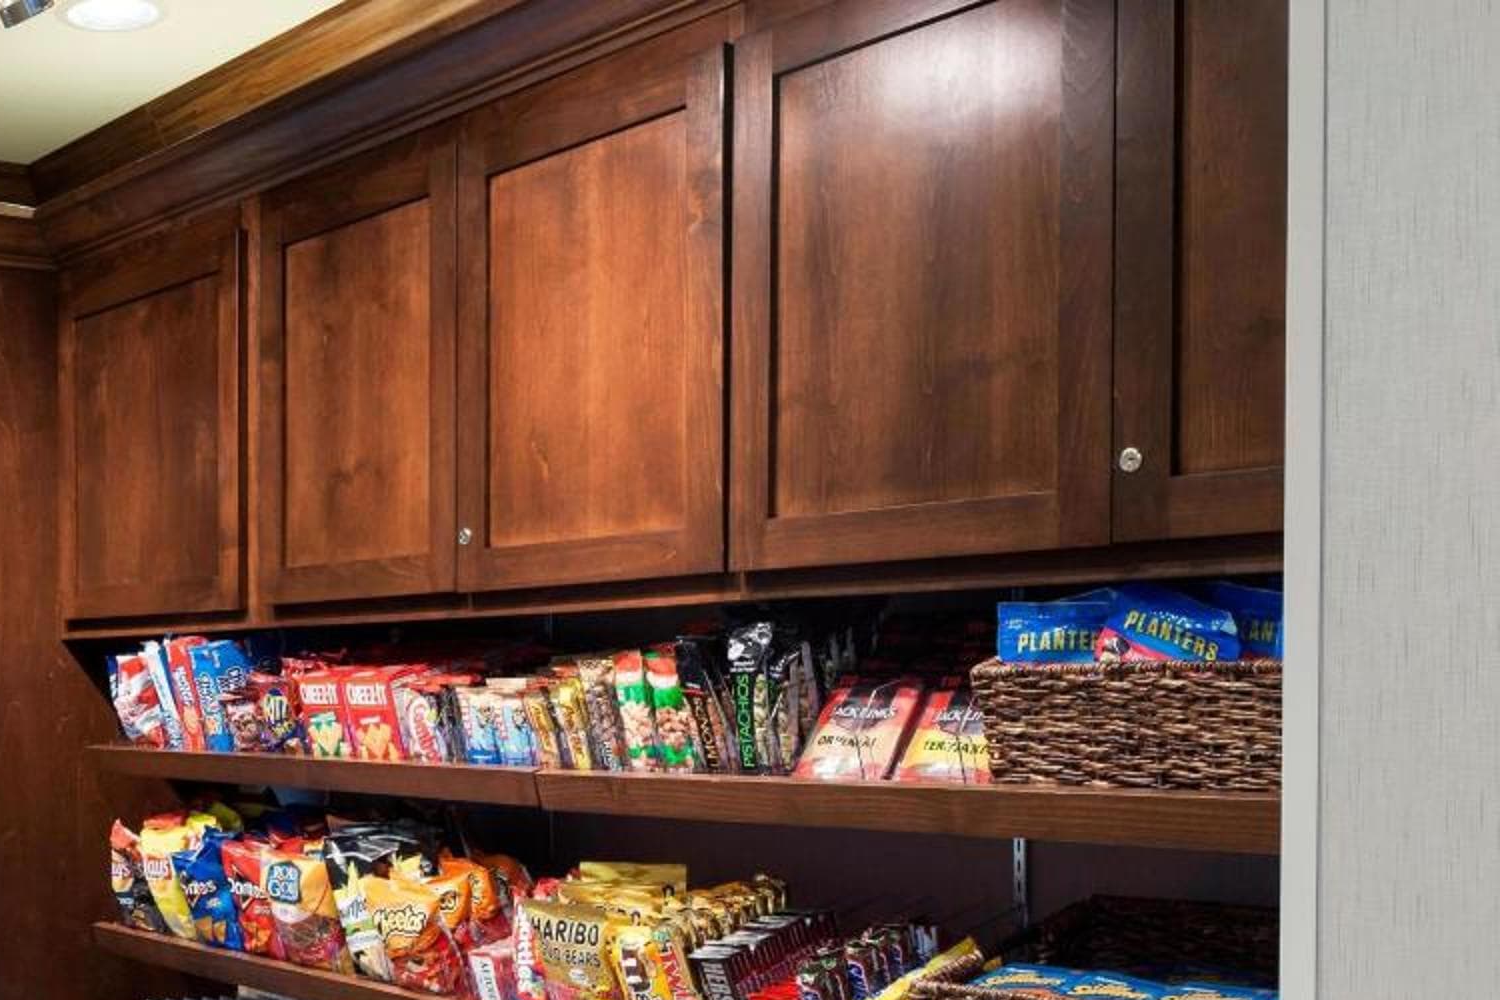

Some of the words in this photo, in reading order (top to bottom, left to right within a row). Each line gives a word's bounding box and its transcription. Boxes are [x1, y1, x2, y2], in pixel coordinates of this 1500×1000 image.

[1017, 629, 1099, 654] PLANTE
[1123, 609, 1219, 661] PLANTERS
[693, 697, 720, 769] LMONDS
[737, 673, 756, 768] PISTACHIOS
[529, 917, 600, 946] HARIBO
